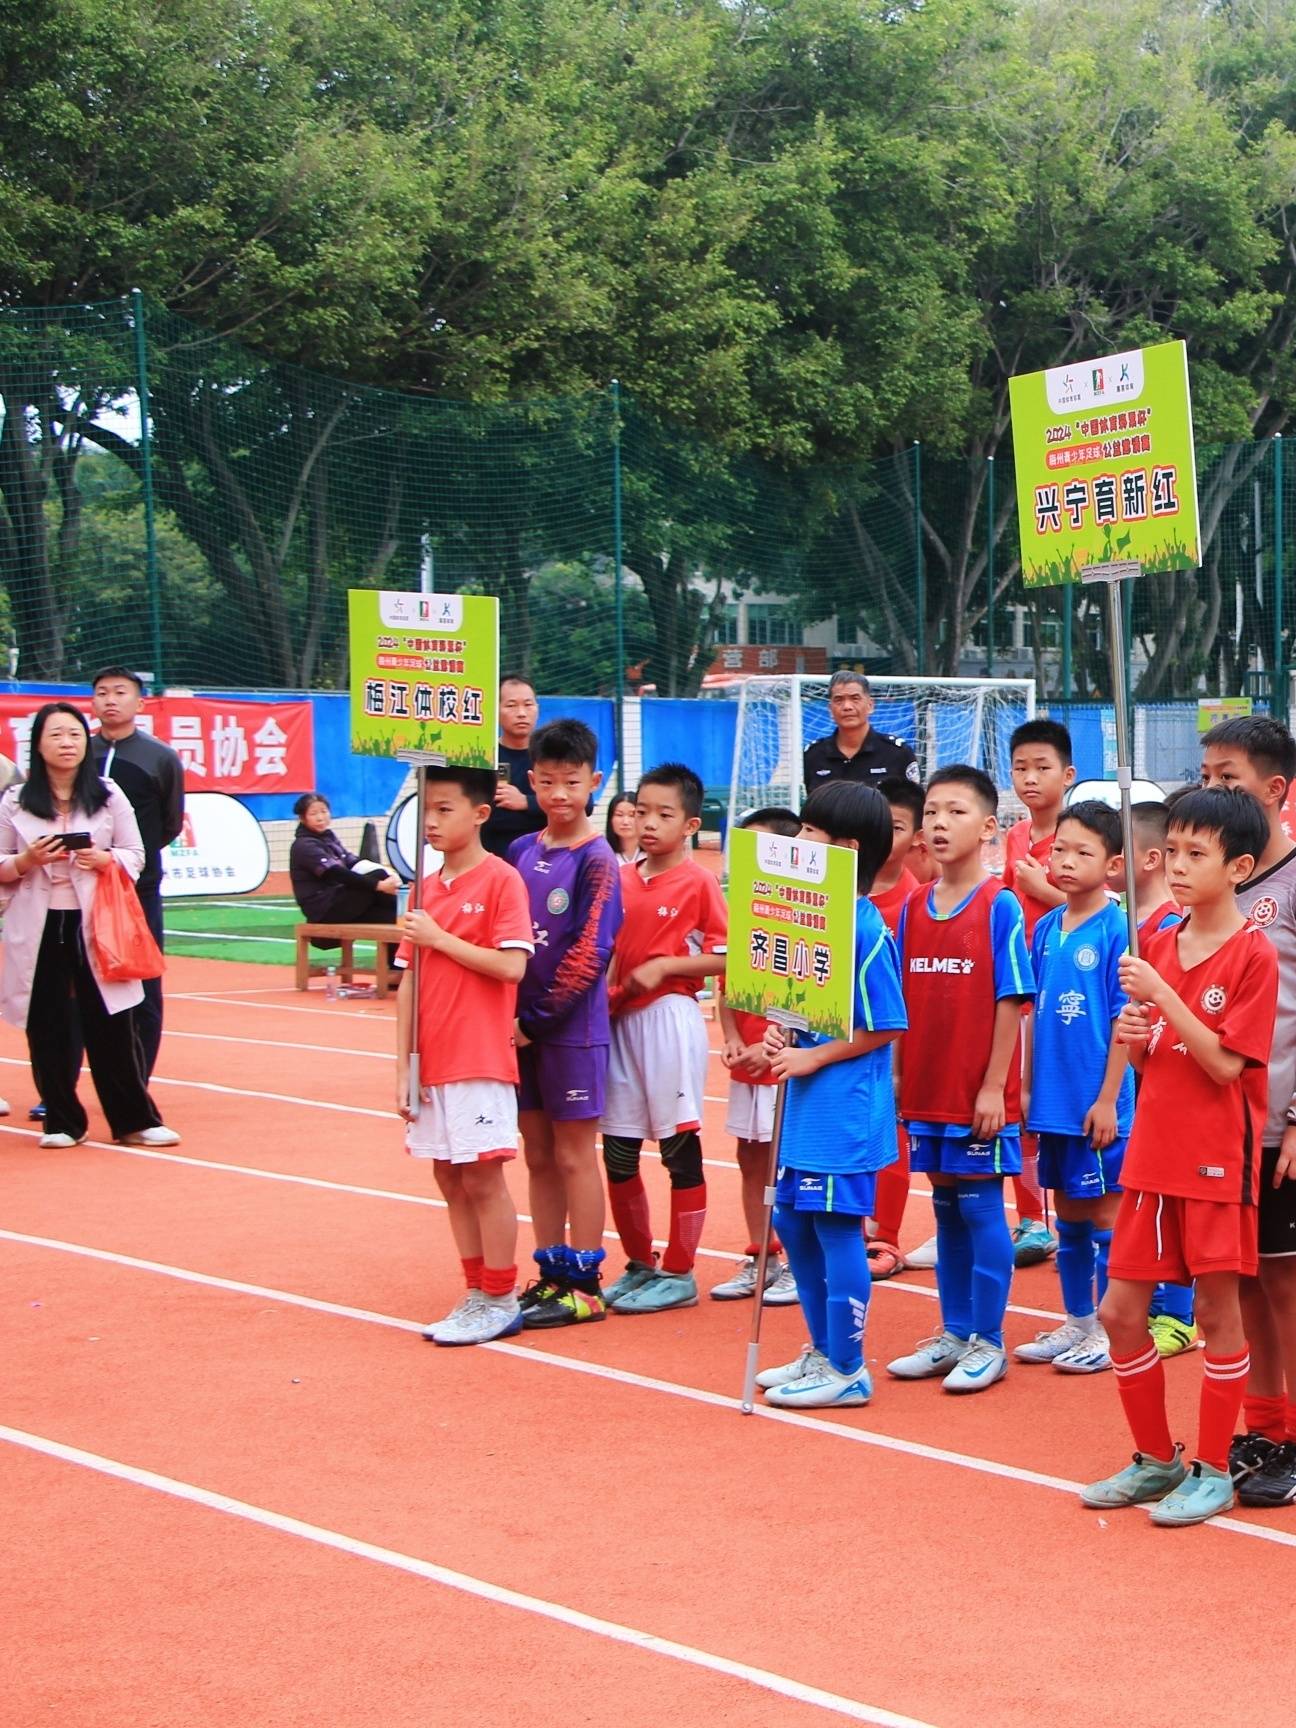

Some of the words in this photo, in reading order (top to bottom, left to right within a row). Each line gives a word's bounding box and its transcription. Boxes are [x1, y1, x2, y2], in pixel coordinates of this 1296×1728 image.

[1046, 425, 1071, 444] 2024
[1036, 467, 1178, 532] 兴宁育新红
[366, 679, 484, 725] 梅江体校红
[751, 929, 831, 986] 齐昌小学
[910, 958, 961, 974] KELME
